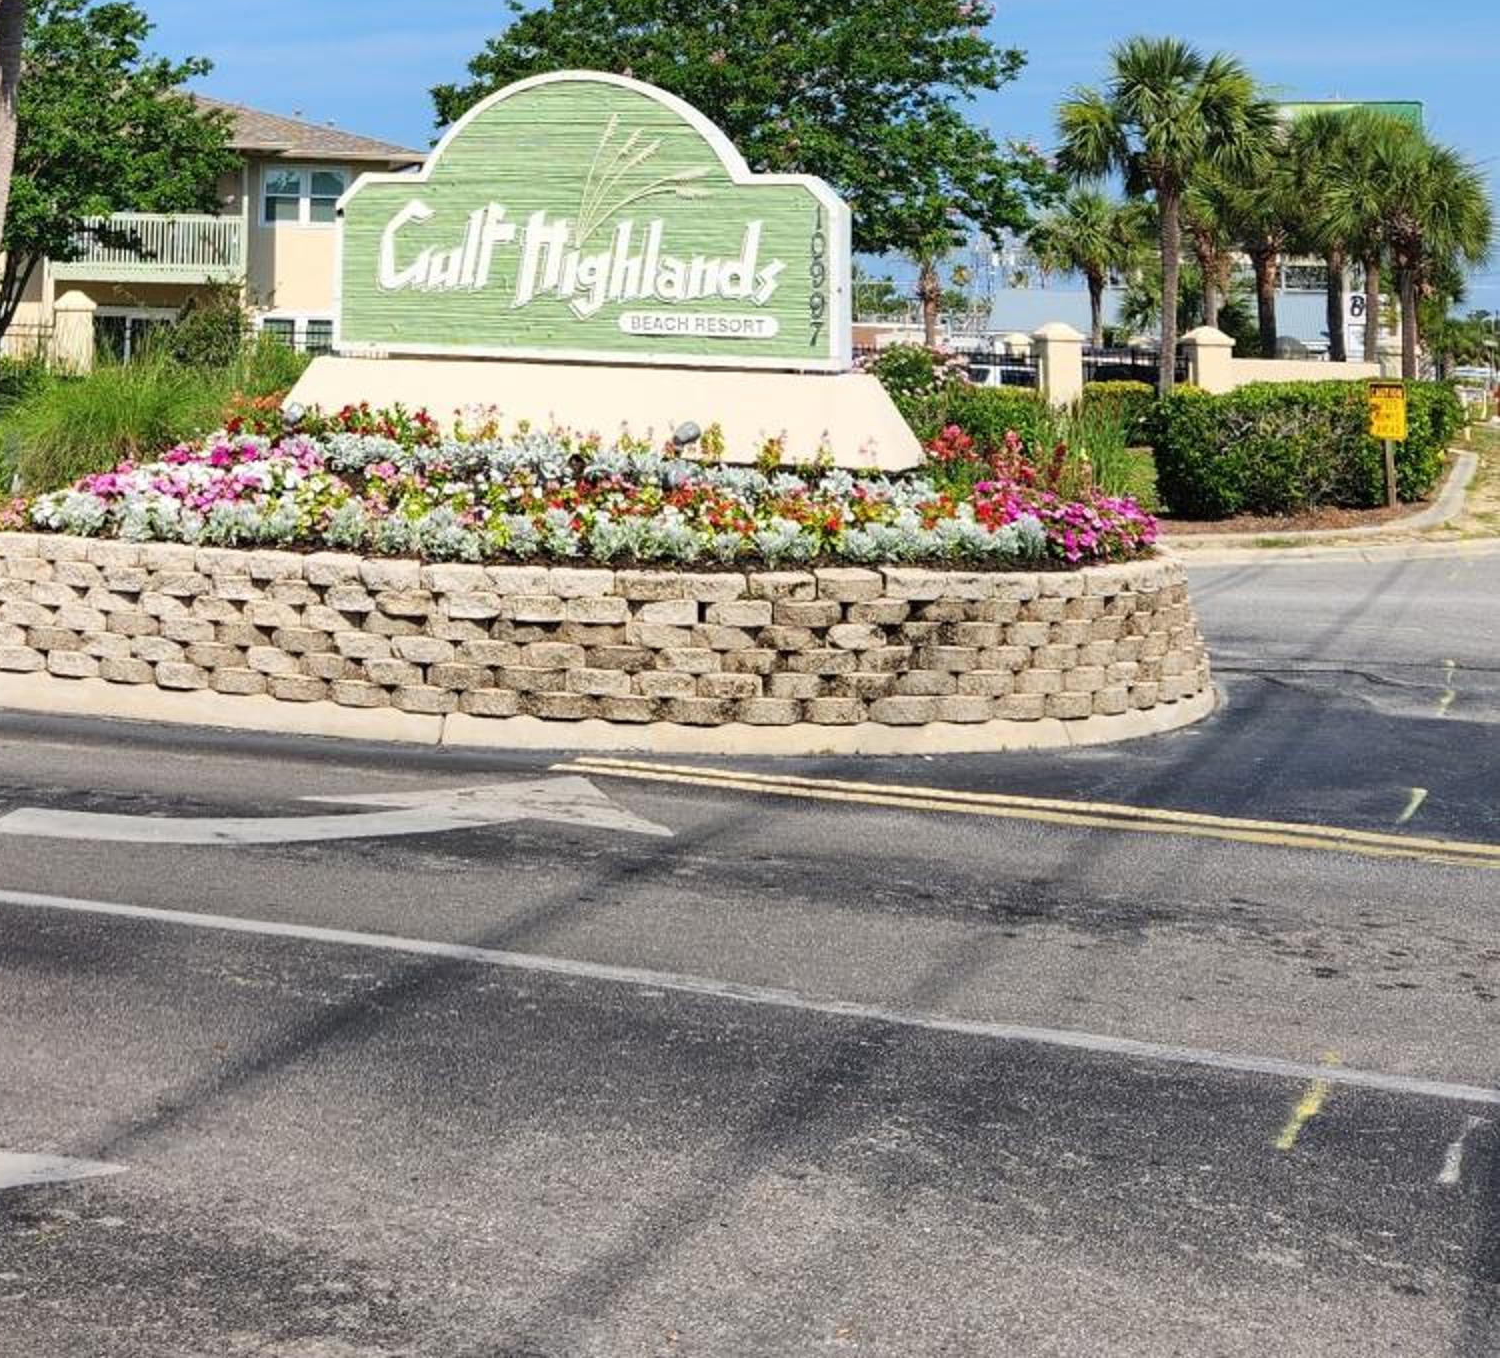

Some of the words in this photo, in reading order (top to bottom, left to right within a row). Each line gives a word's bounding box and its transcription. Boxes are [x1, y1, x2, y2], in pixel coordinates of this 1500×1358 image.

[378, 198, 517, 291] Gulf
[510, 209, 787, 321] Highlands
[809, 203, 826, 347] 10997
[630, 315, 689, 332] BEACH
[694, 317, 766, 334] RESORT
